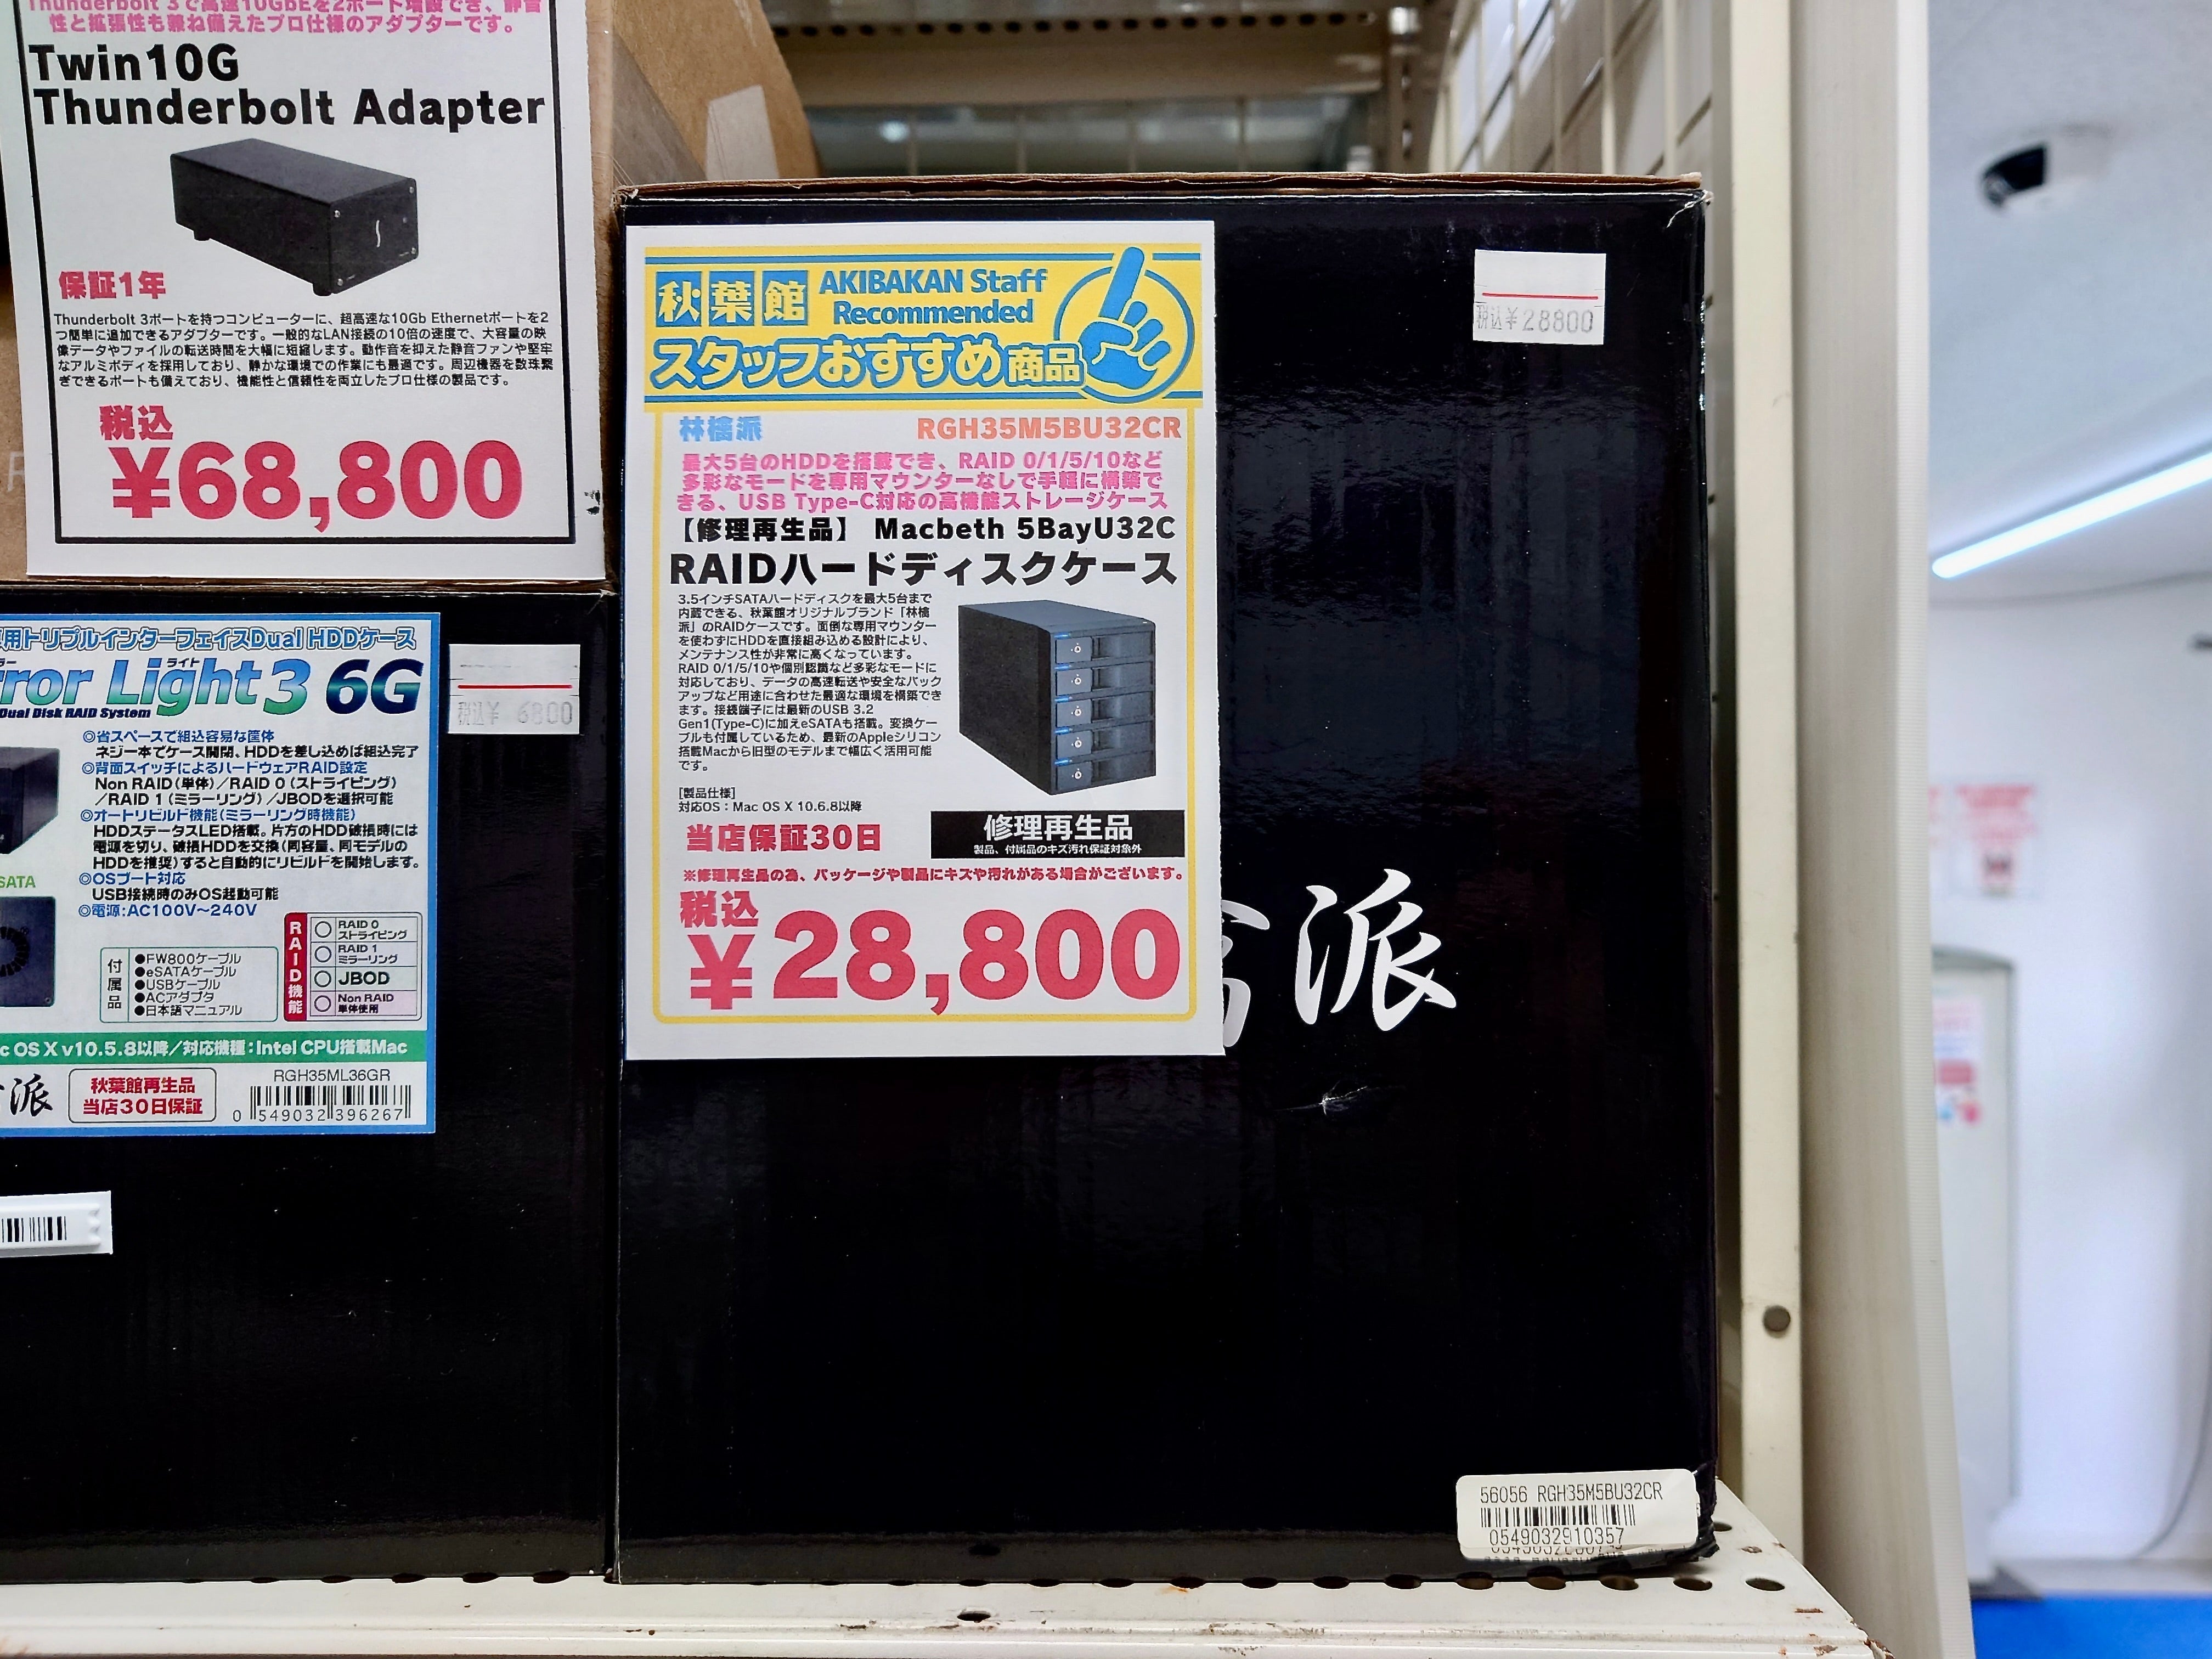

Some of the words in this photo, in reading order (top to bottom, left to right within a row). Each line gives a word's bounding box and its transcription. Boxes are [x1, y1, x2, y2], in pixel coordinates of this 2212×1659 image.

[49, 13, 512, 33] 性と拡張性も兼ね備えたプロ仕様のアダプターです。
[29, 43, 239, 81] Twin10G
[33, 88, 335, 125] Thunderbolt
[353, 88, 545, 133] Adapter
[59, 271, 166, 299] 保証1年
[819, 269, 963, 295] AKIBAKAN
[970, 268, 1048, 293] Staff
[658, 280, 806, 323] 秋葉館
[54, 313, 135, 326] Thunderbolt
[140, 312, 426, 326] 3ポートを持つコンピューターに、超高速な10Gb
[431, 311, 549, 325] Ethernetポートを2
[833, 298, 1033, 325] Recommended
[55, 327, 547, 341] つ簡単に追加できるアダプターです。一般的なLAN接続の10倍の速度で、大容量の映
[57, 342, 553, 357] 像データやファイルの転送時間を大幅に短縮します。動作音を抑えた静音ファンや堅牢
[652, 334, 1083, 387] スタッフおすすめ商品
[59, 373, 509, 387] ぎできるポートも備えており、機能性と信頼性を両立したプロ仕様の製品です。
[100, 405, 173, 441] 税込
[679, 415, 763, 442] 林檎派
[917, 416, 1181, 440] RGH35M5BU32CR
[1023, 450, 1163, 470] 0/1/5/10など
[108, 441, 522, 533] ¥68,800
[683, 471, 1163, 492] 多彩なモードを専用マウンターなしで手軽に構築で
[794, 491, 1167, 514] Type-C対応の高機能ストレージケース
[684, 517, 847, 543] 【修理再生品】
[874, 517, 1005, 540] Macbeth
[1017, 515, 1176, 545] 5BayU32C
[670, 551, 1178, 587] RAIDハードディスクケース
[678, 592, 933, 605] 3.5インチSATAハードディスクを最大5台まで
[678, 620, 936, 633] 派」のRAIDケースです。面倒な専用マウンター
[0, 627, 302, 651] 用トリプルインターフェイスDual
[308, 627, 416, 650] HDDケース
[678, 634, 928, 646] を使わずにHDDを直接組み込める設計により、
[679, 648, 912, 660] メンテナンス性が非常に高くなっています。
[167, 658, 200, 668] ライト
[678, 663, 709, 674] RAID
[713, 662, 937, 674] 0/1/5/10や個別認識など多彩なモードに
[325, 658, 424, 714] 6G
[678, 675, 942, 688] 対応しており、データの高速転送や安全なバック
[678, 690, 942, 702] アップなど用途に合わせた最適な環境を構築でき
[32, 708, 63, 719] Disk
[65, 708, 97, 719] RAID
[99, 708, 151, 720] System
[679, 704, 849, 716] ます。接続端子には最新のUSB
[853, 704, 874, 715] 3.2
[678, 731, 941, 744] ブルも付属しているため、最新のAppleシリコン
[678, 745, 932, 757] 搭載Macから旧型のモデルまで幅広く活用可能
[678, 760, 708, 771] です。
[95, 777, 128, 791] Non
[678, 787, 736, 799] [製品仕様]
[762, 801, 780, 812] OS
[784, 801, 793, 812] X
[798, 800, 862, 813] 10.6.8以降
[984, 814, 1133, 842] 修理再生品
[686, 823, 881, 852] 当店保証30日
[974, 843, 1142, 855] 製品、付属品のキズ汚れ保証対象外
[92, 887, 279, 901] USB接続時のみOS起動可能
[680, 890, 759, 928] 税込
[338, 920, 368, 929] RAID
[371, 920, 379, 929] 0
[338, 930, 408, 940] ストライピング
[338, 944, 368, 953] RAID
[373, 944, 377, 952] 1
[146, 953, 241, 965] FW800ケーブル
[338, 954, 398, 964] ミラーリング
[687, 909, 1181, 1016] ¥28,800
[146, 966, 236, 978] eSATAケーブル
[338, 972, 390, 985] JBOD
[108, 958, 122, 1009] 付属品
[146, 979, 221, 991] USBケーブル
[146, 991, 214, 1003] ACアダプタ
[338, 994, 362, 1002] Non
[364, 994, 394, 1002] RAID
[146, 1005, 242, 1017] 日本語マニュアル
[338, 1004, 379, 1014] 単体使用
[13, 1042, 40, 1057] OS
[43, 1041, 58, 1057] X
[301, 1039, 408, 1055] CPU搭載Mac
[274, 1069, 391, 1082] RGH35ML36GR
[91, 1077, 195, 1094] 秋葉館再生品
[0, 1073, 53, 1117] 派
[83, 1098, 203, 1115] 当店30日保証
[1480, 1486, 1528, 1504] 56056
[1537, 1482, 1663, 1503] RGH35M5BU32CR
[1489, 1527, 1624, 1546] 0549032910357
